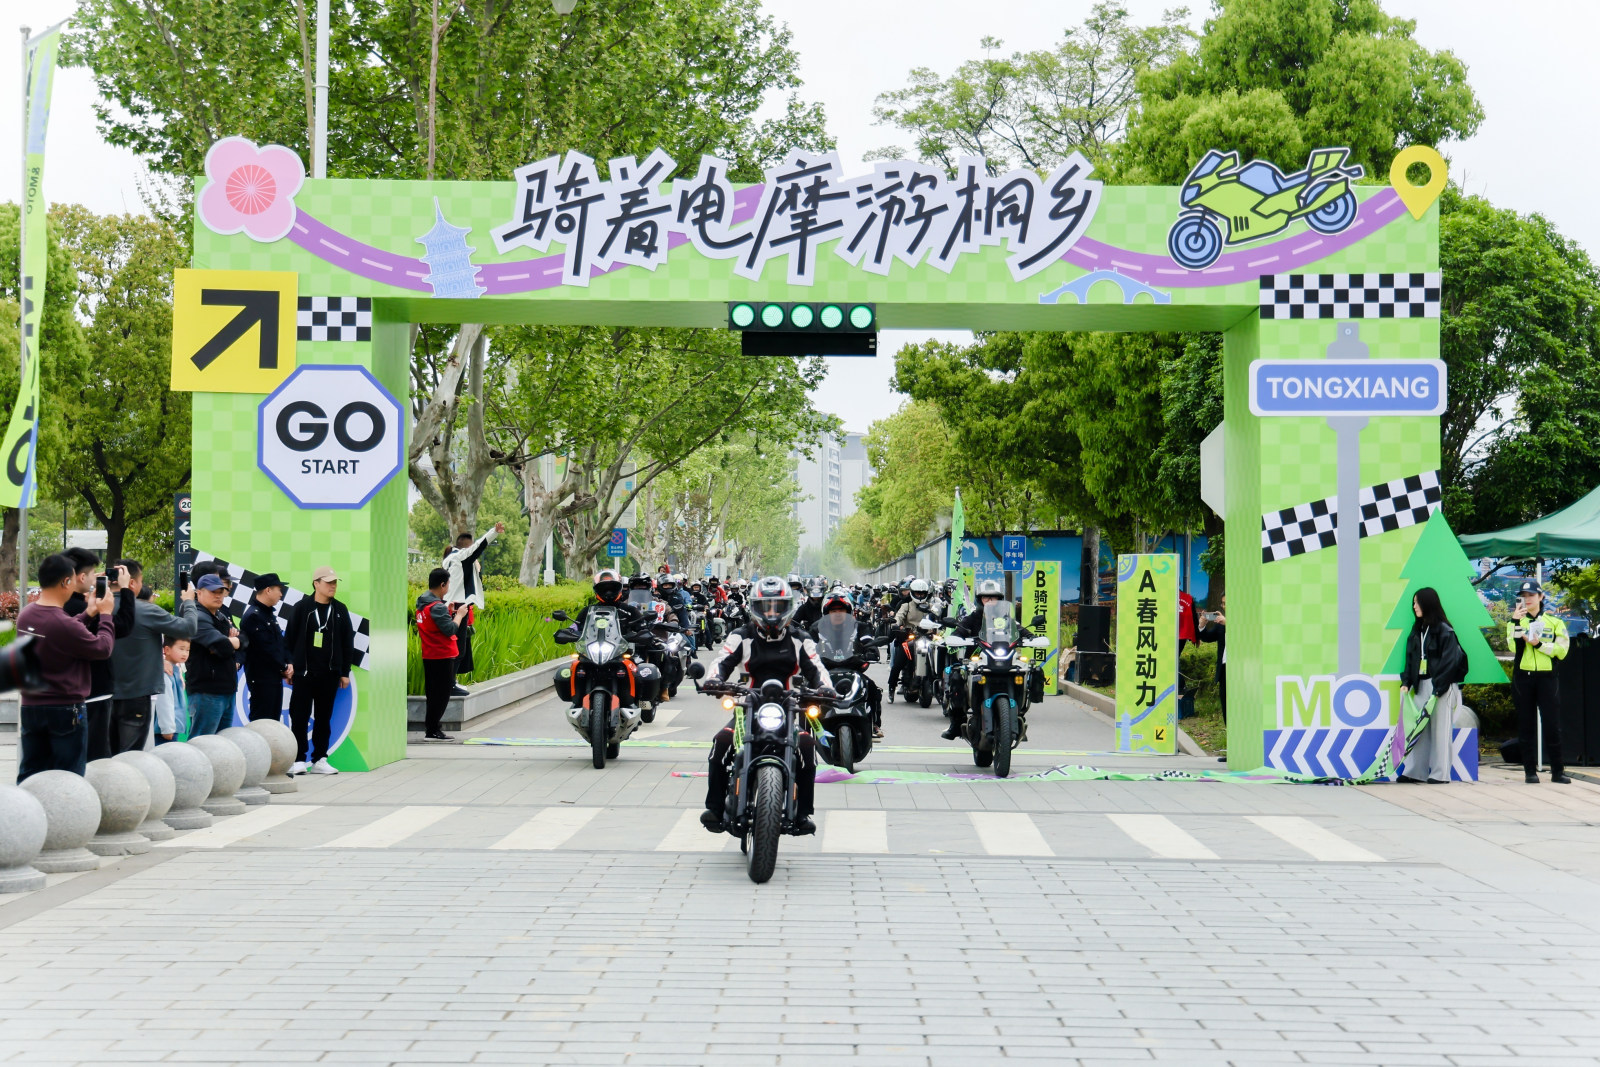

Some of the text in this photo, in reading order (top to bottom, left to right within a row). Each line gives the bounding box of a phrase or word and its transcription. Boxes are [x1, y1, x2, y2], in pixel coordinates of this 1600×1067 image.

[502, 159, 1092, 277] 骑着电摩游桐乡
[1266, 376, 1429, 399] TONGXIANG
[275, 400, 386, 453] GO
[301, 459, 360, 474] START
[181, 501, 192, 509] 20
[1033, 570, 1048, 662] B骑行团
[1282, 679, 1401, 727] MOT
